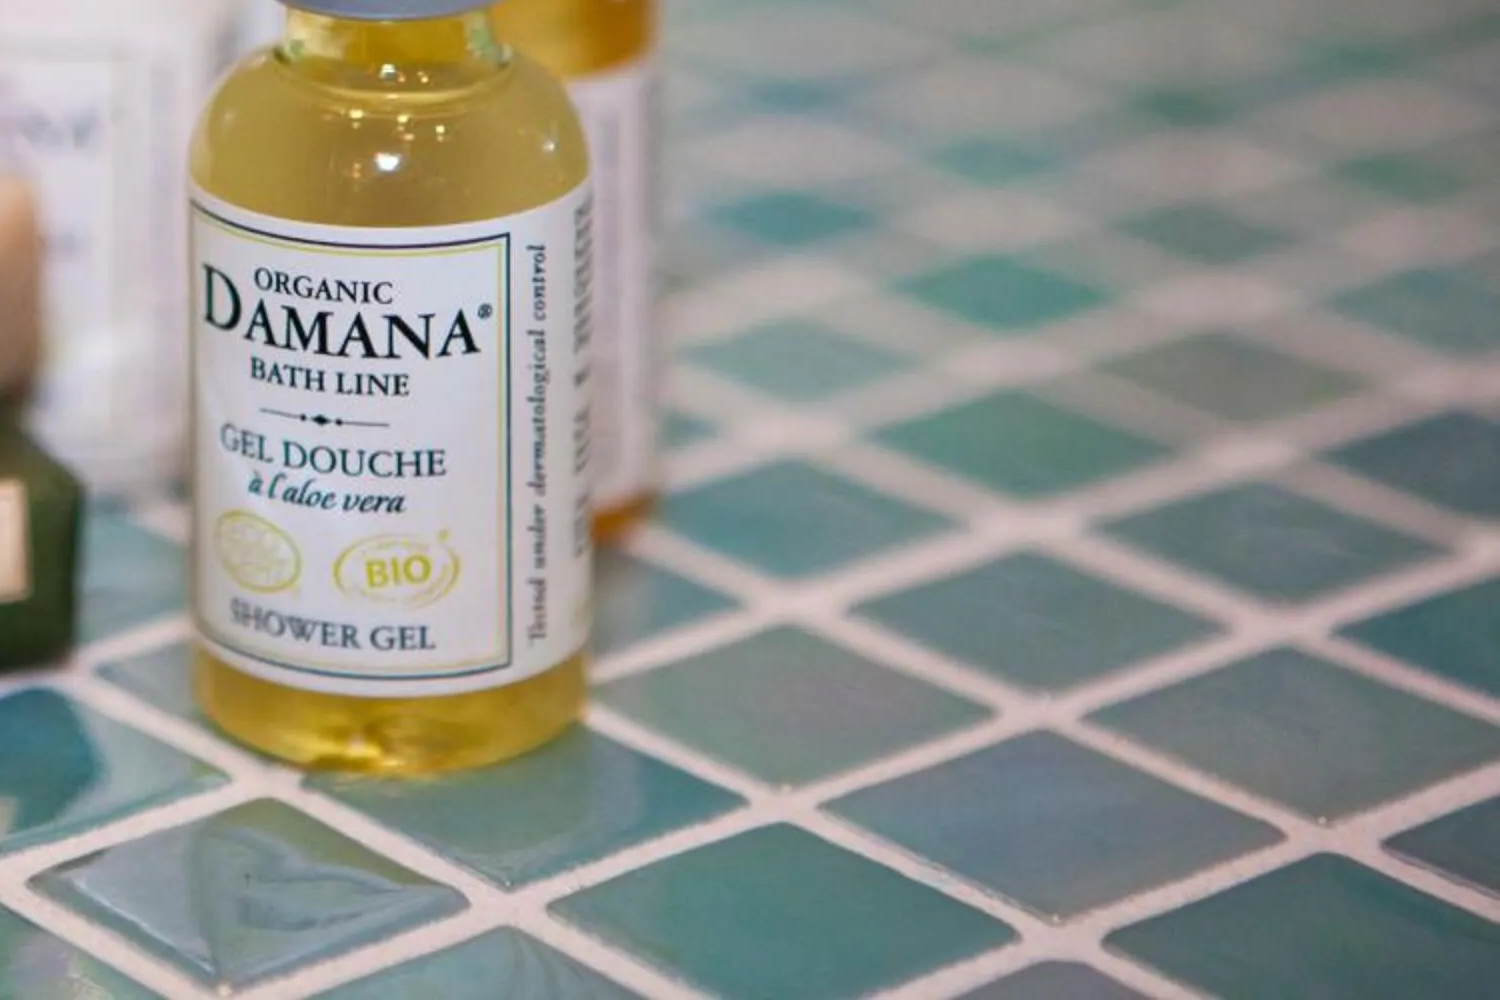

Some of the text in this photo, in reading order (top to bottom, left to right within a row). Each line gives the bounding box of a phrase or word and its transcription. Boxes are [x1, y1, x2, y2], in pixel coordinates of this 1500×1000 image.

[254, 267, 394, 305] ORGANIC
[526, 244, 547, 321] control
[250, 356, 410, 398] BATH LINE
[526, 330, 552, 496] dermatological
[220, 422, 447, 479] GEL DOUCHE
[247, 470, 407, 515] à l'aloe vera
[527, 504, 547, 568] under
[365, 554, 431, 589] BIO
[230, 597, 437, 652] SHOWER GEL
